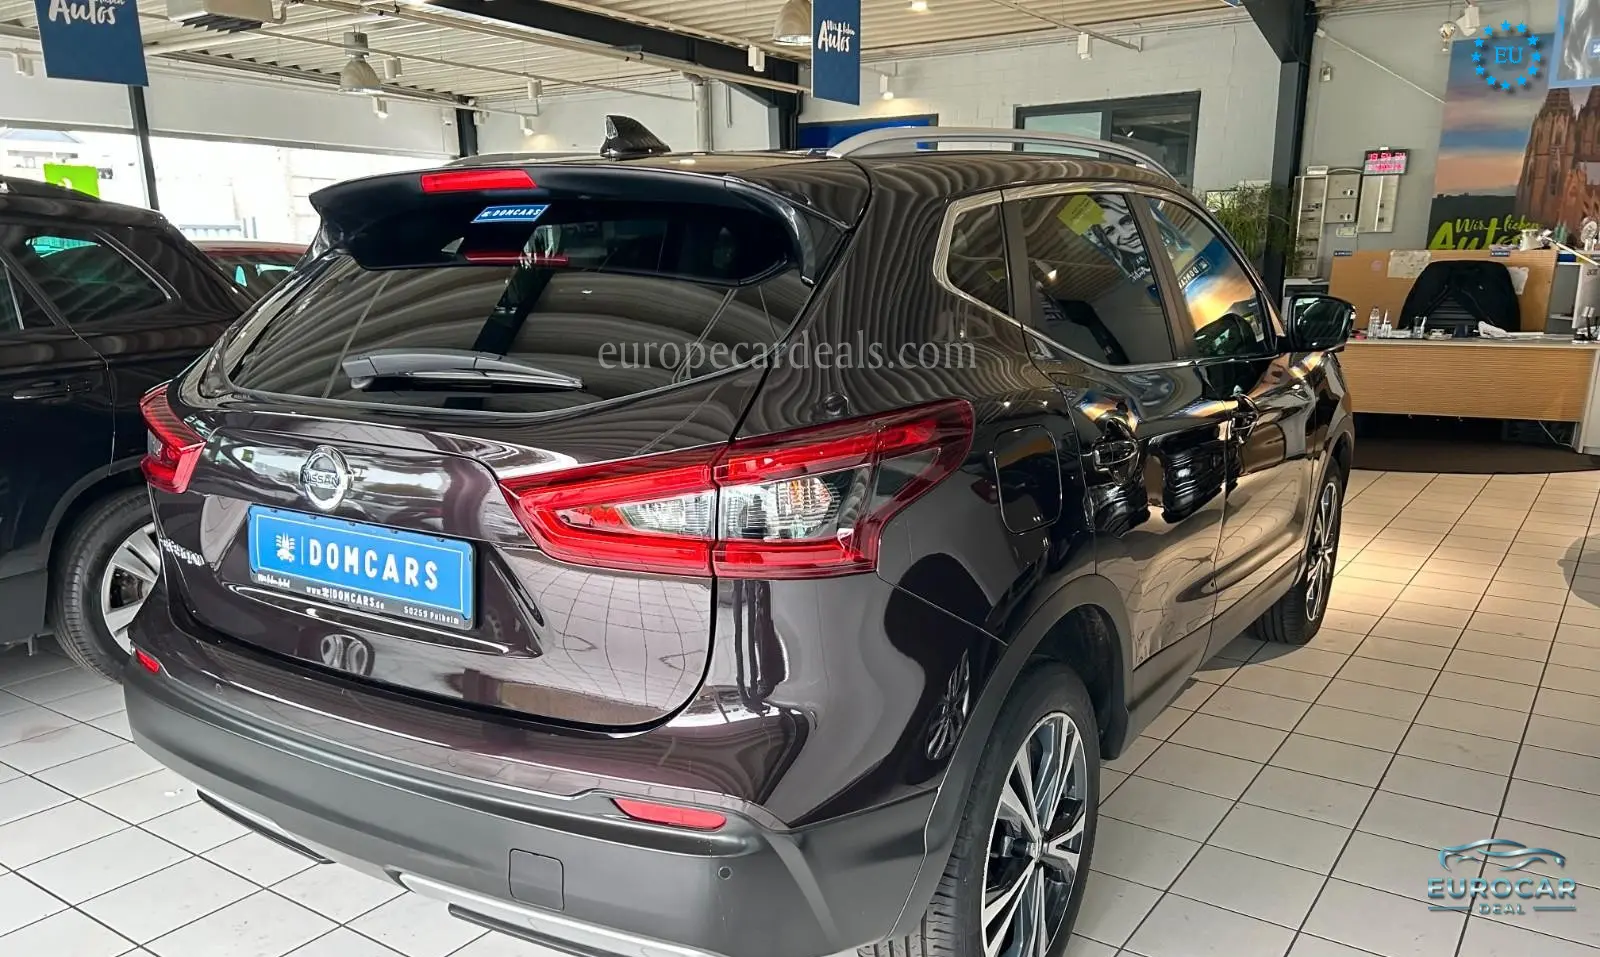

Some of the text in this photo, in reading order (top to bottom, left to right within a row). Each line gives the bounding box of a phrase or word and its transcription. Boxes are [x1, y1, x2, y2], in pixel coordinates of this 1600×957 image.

[48, 0, 116, 25] Autos
[818, 20, 850, 52] Autos
[492, 209, 542, 217] DOMCARS
[1455, 218, 1485, 233] Wir
[303, 470, 340, 488] NISSAN
[309, 537, 439, 592] DOMCARS
[403, 605, 460, 626] 50259 Pulheim
